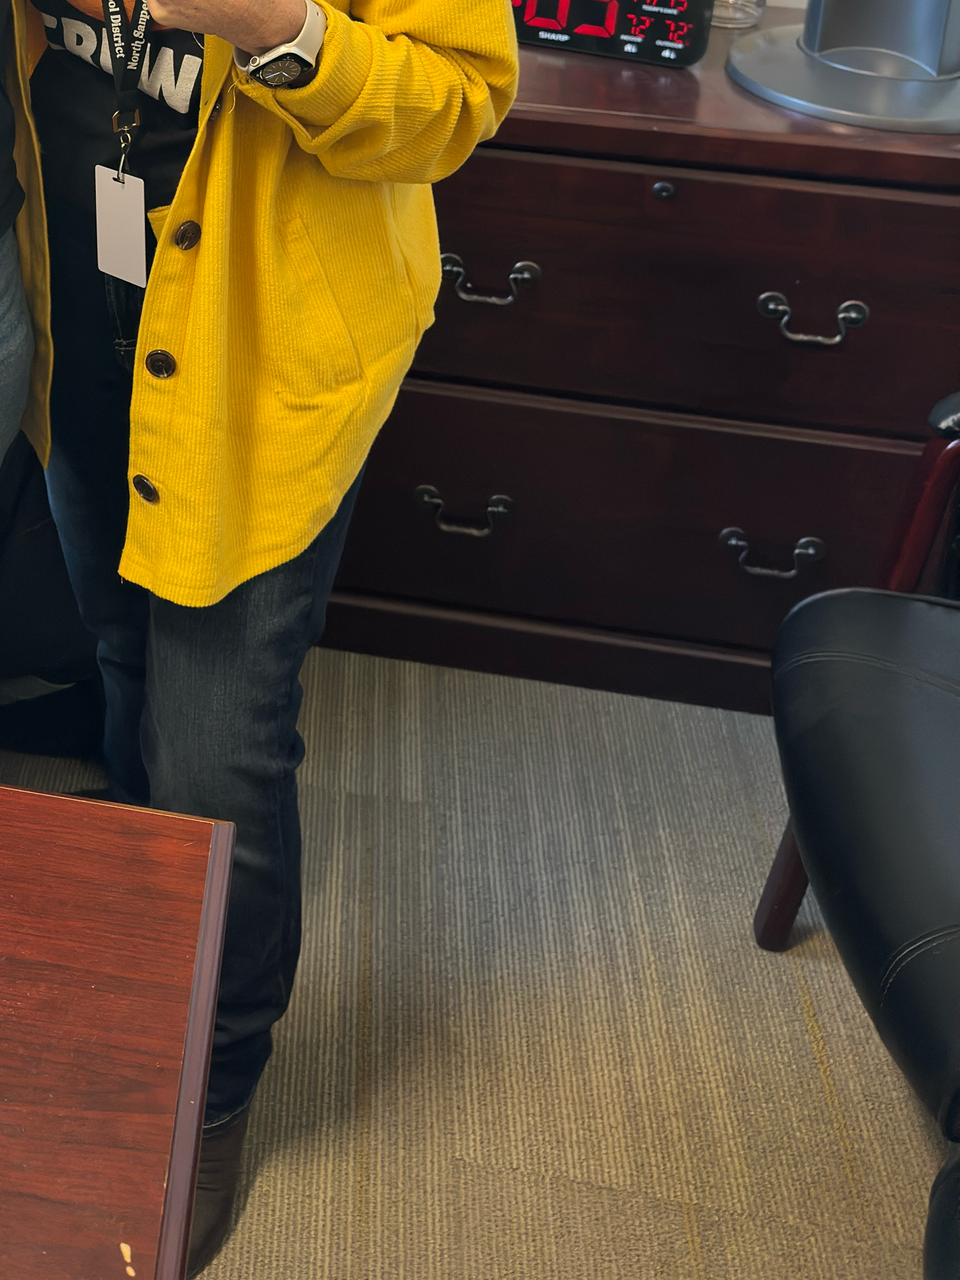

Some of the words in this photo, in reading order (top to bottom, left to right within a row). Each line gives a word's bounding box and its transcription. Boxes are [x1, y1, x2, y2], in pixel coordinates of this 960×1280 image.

[110, 9, 126, 59] District
[538, 30, 571, 42] SHARP
[620, 34, 644, 43] INDOOR
[655, 39, 686, 50] OUTDOOR
[126, 39, 143, 71] North
